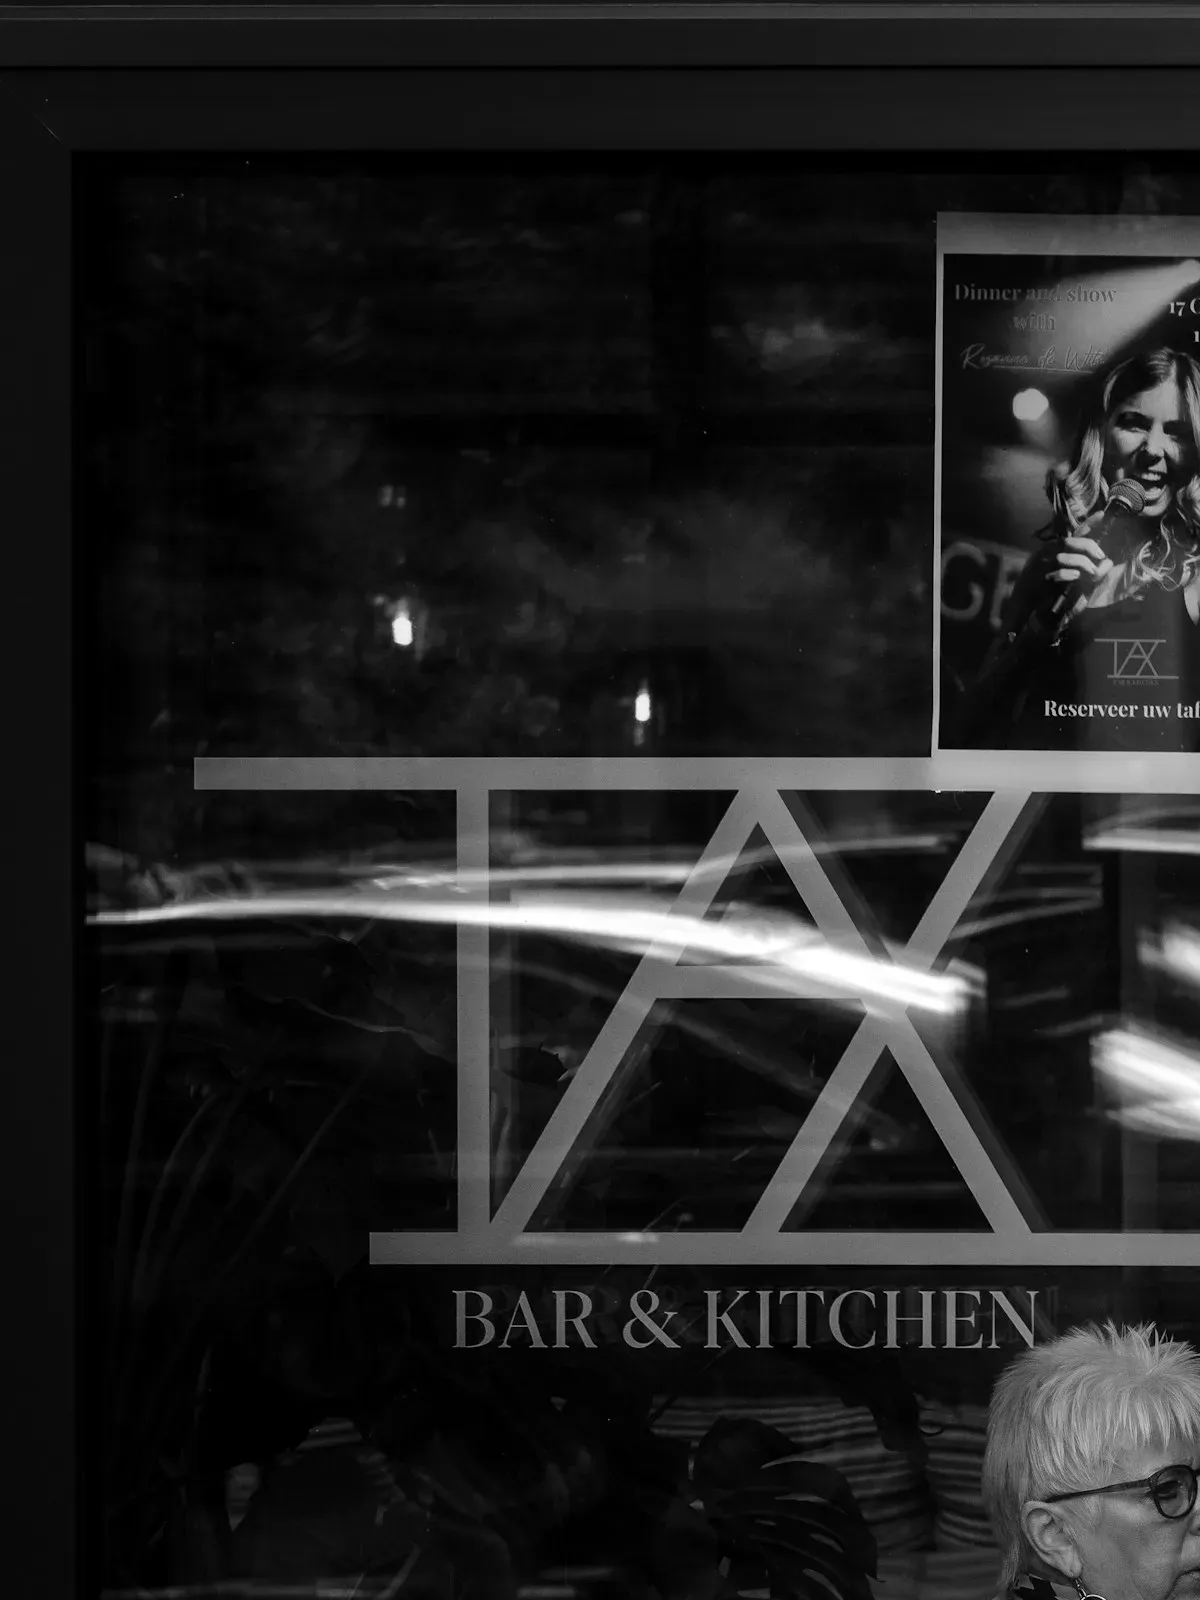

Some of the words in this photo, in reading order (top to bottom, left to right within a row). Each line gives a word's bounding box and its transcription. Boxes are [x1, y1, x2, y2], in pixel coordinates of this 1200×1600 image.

[955, 284, 1021, 301] Dinner
[1026, 285, 1061, 302] and
[1066, 284, 1117, 302] show
[1169, 300, 1186, 317] 17
[1013, 312, 1057, 331] with
[1044, 700, 1139, 718] Reserveer
[1143, 703, 1171, 718] uw
[452, 1290, 598, 1349] BAR
[622, 1289, 682, 1349] &
[704, 1290, 1040, 1350] KITCHEN
